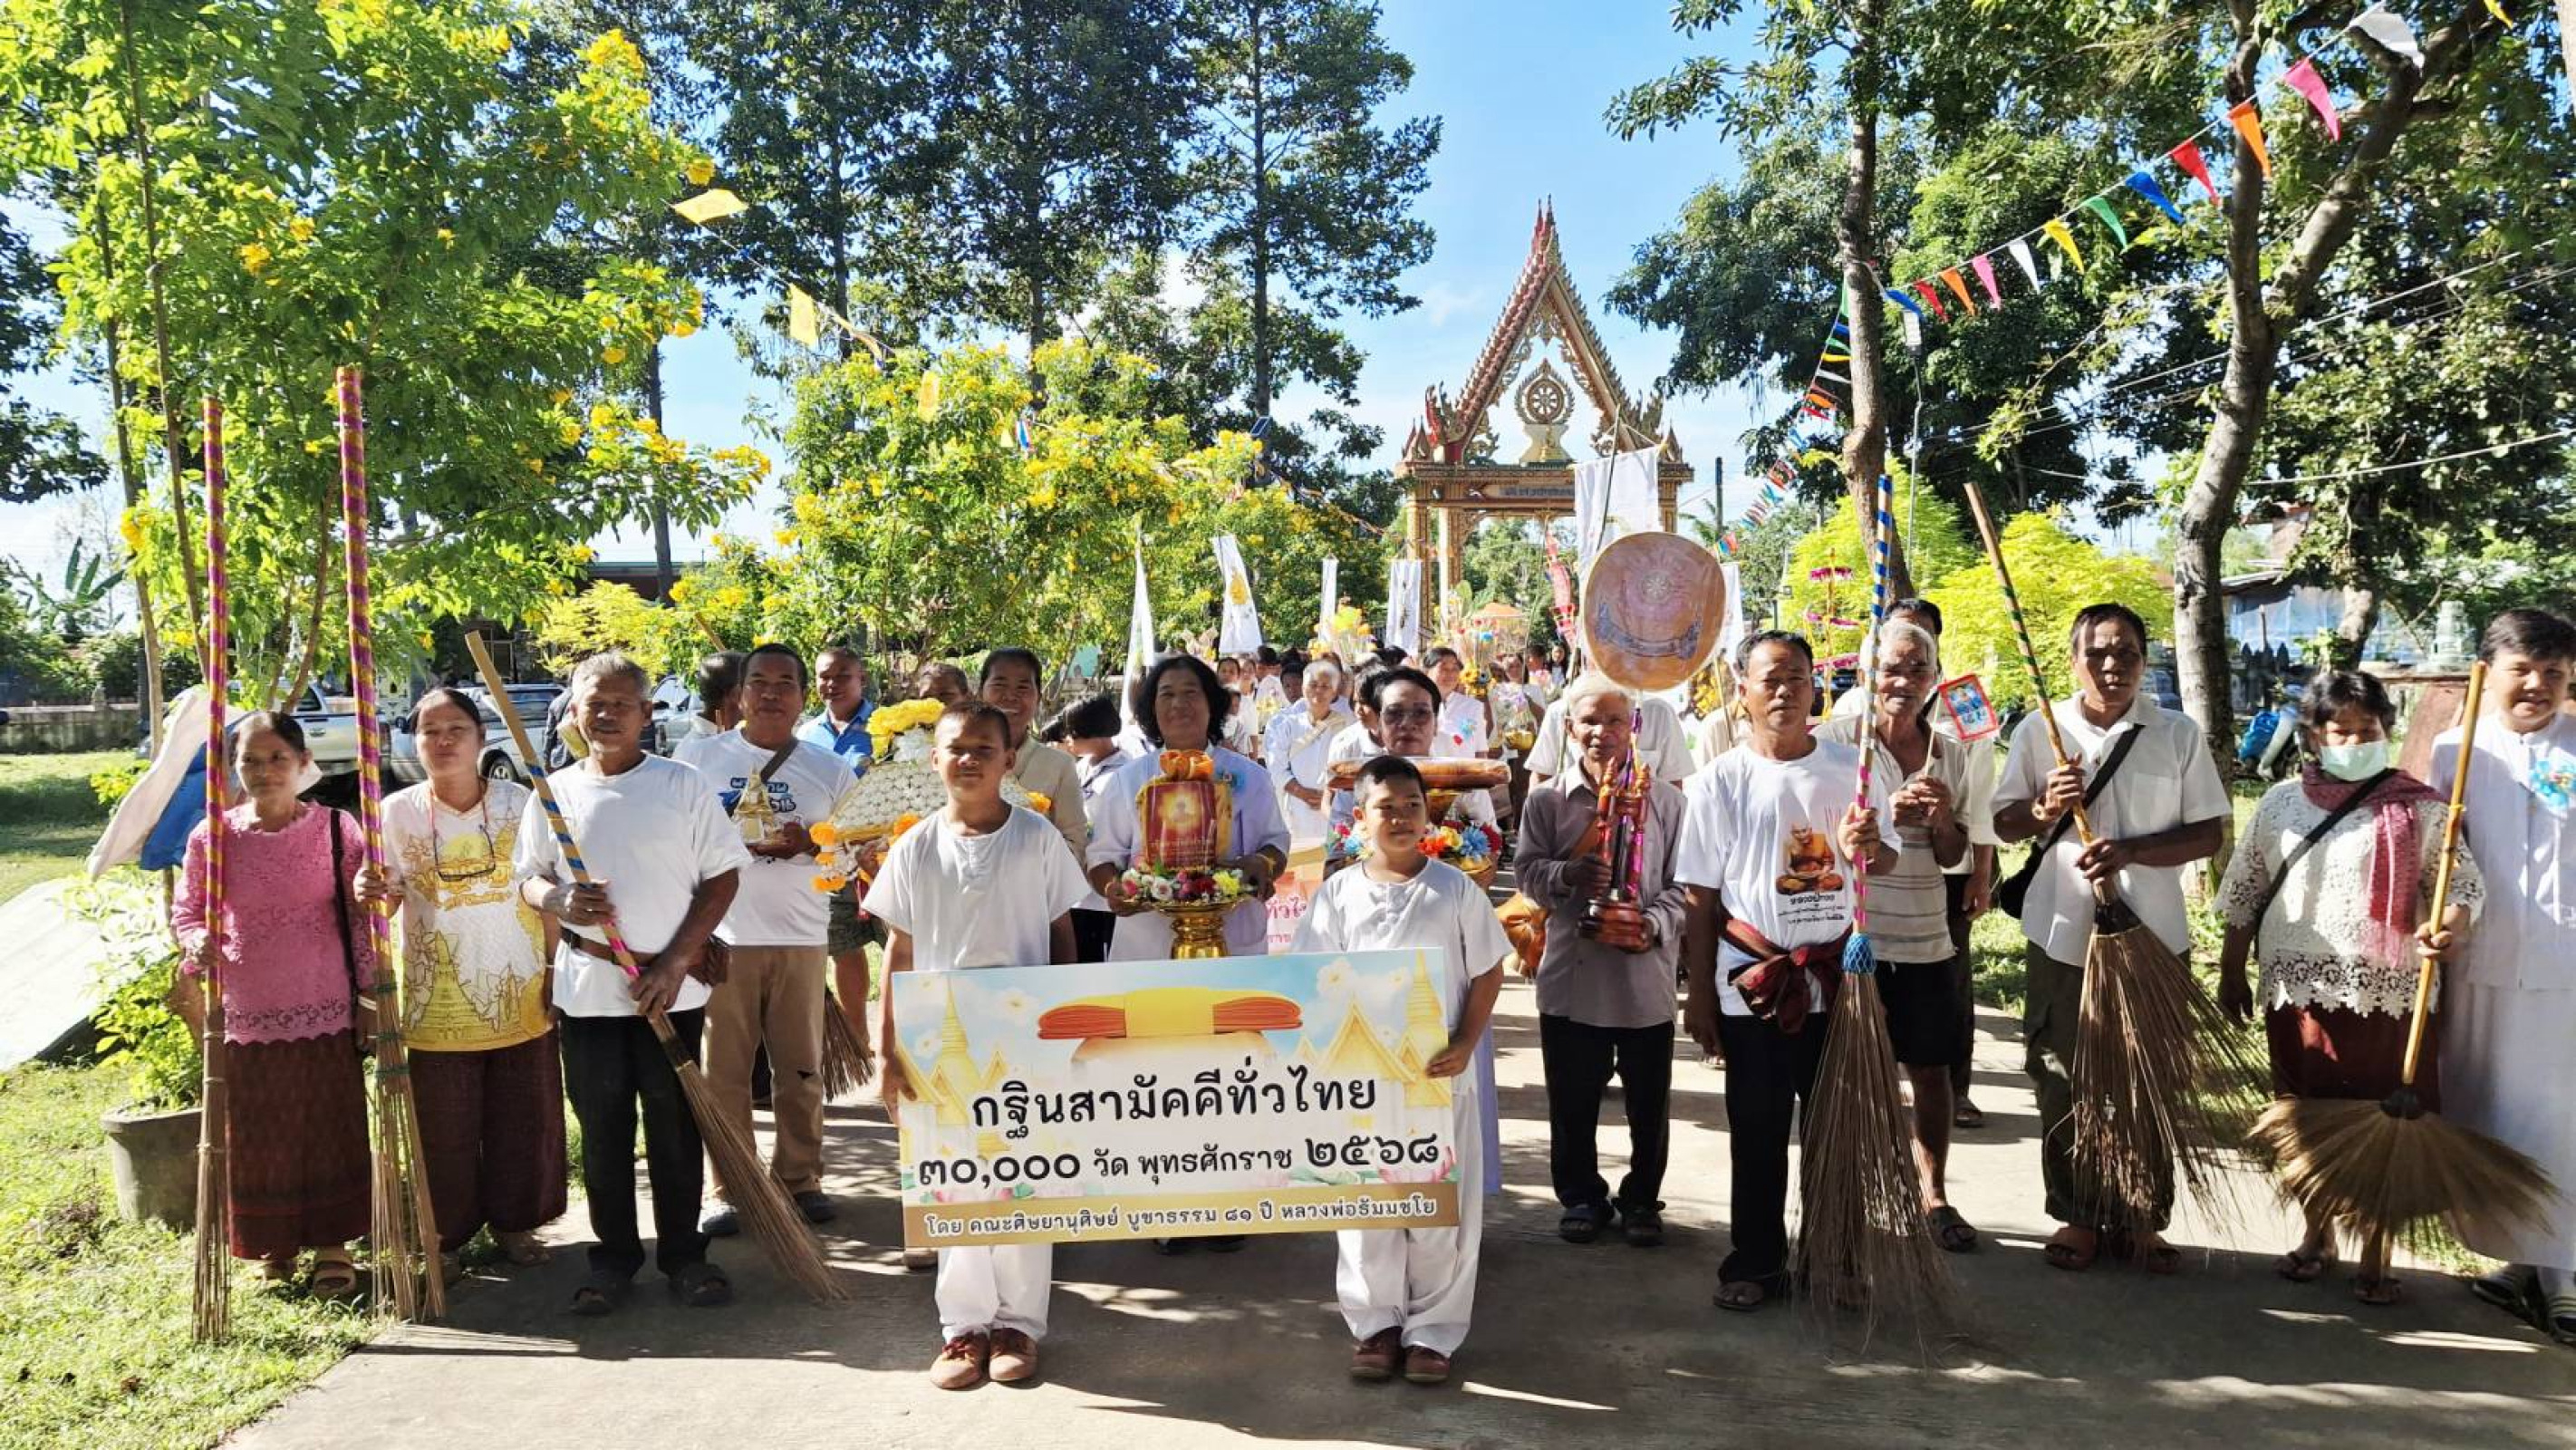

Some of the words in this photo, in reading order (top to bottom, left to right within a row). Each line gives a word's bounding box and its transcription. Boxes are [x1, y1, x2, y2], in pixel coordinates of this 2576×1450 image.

[972, 1055, 1376, 1138] กฐินสามัคคีทั่วไทย
[919, 1153, 1081, 1189] ๓๐,๐๐๐
[1093, 1147, 1129, 1177] วัด
[1138, 1143, 1292, 1184] พุทธศักราช
[1305, 1133, 1439, 1167] ๒๕๖๘
[926, 1214, 962, 1235] โดย
[970, 1206, 1119, 1233] คณะศิษยานุศิษย์
[1225, 1209, 1251, 1221] ๘๑
[1259, 1200, 1273, 1219] ปี
[1281, 1195, 1435, 1219] หลวงพ่อธัมมชโย
